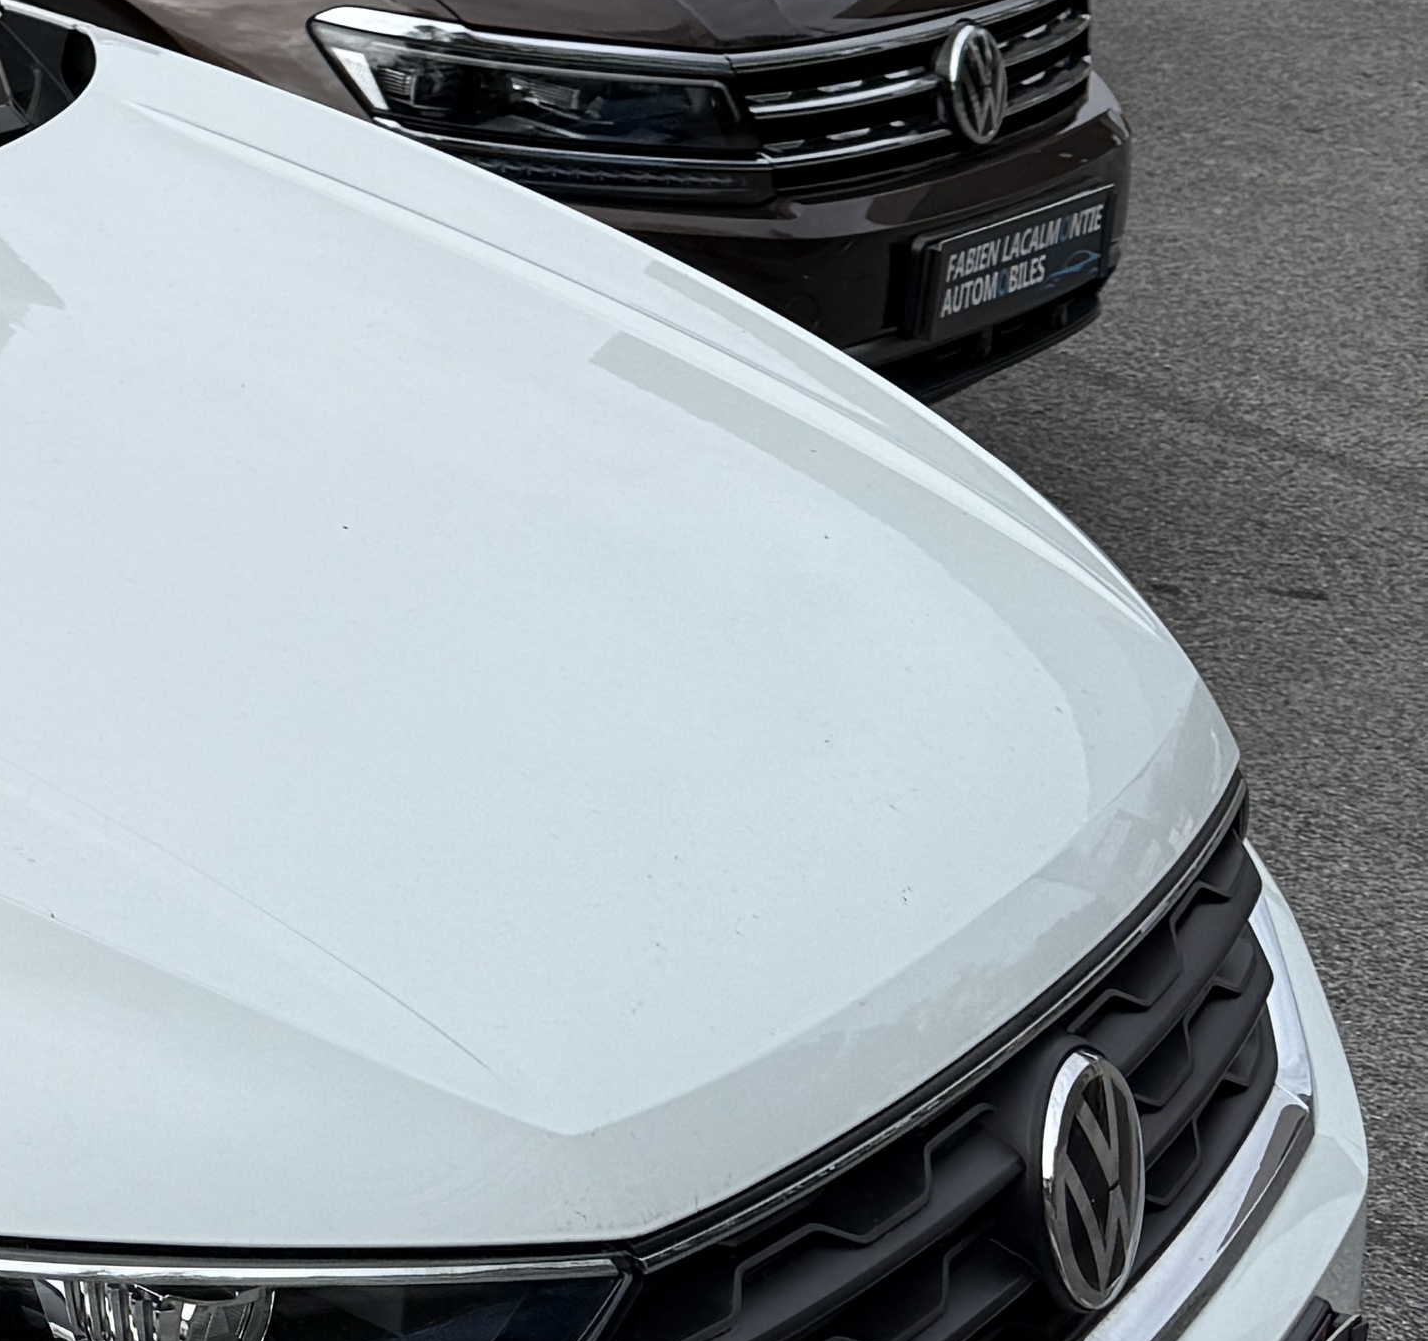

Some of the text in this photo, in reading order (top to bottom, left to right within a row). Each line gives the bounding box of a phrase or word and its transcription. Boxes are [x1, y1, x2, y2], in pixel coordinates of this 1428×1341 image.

[946, 203, 1104, 283] FABIEN LACALMONTIE
[939, 254, 1047, 318] AUTOMOBILES
